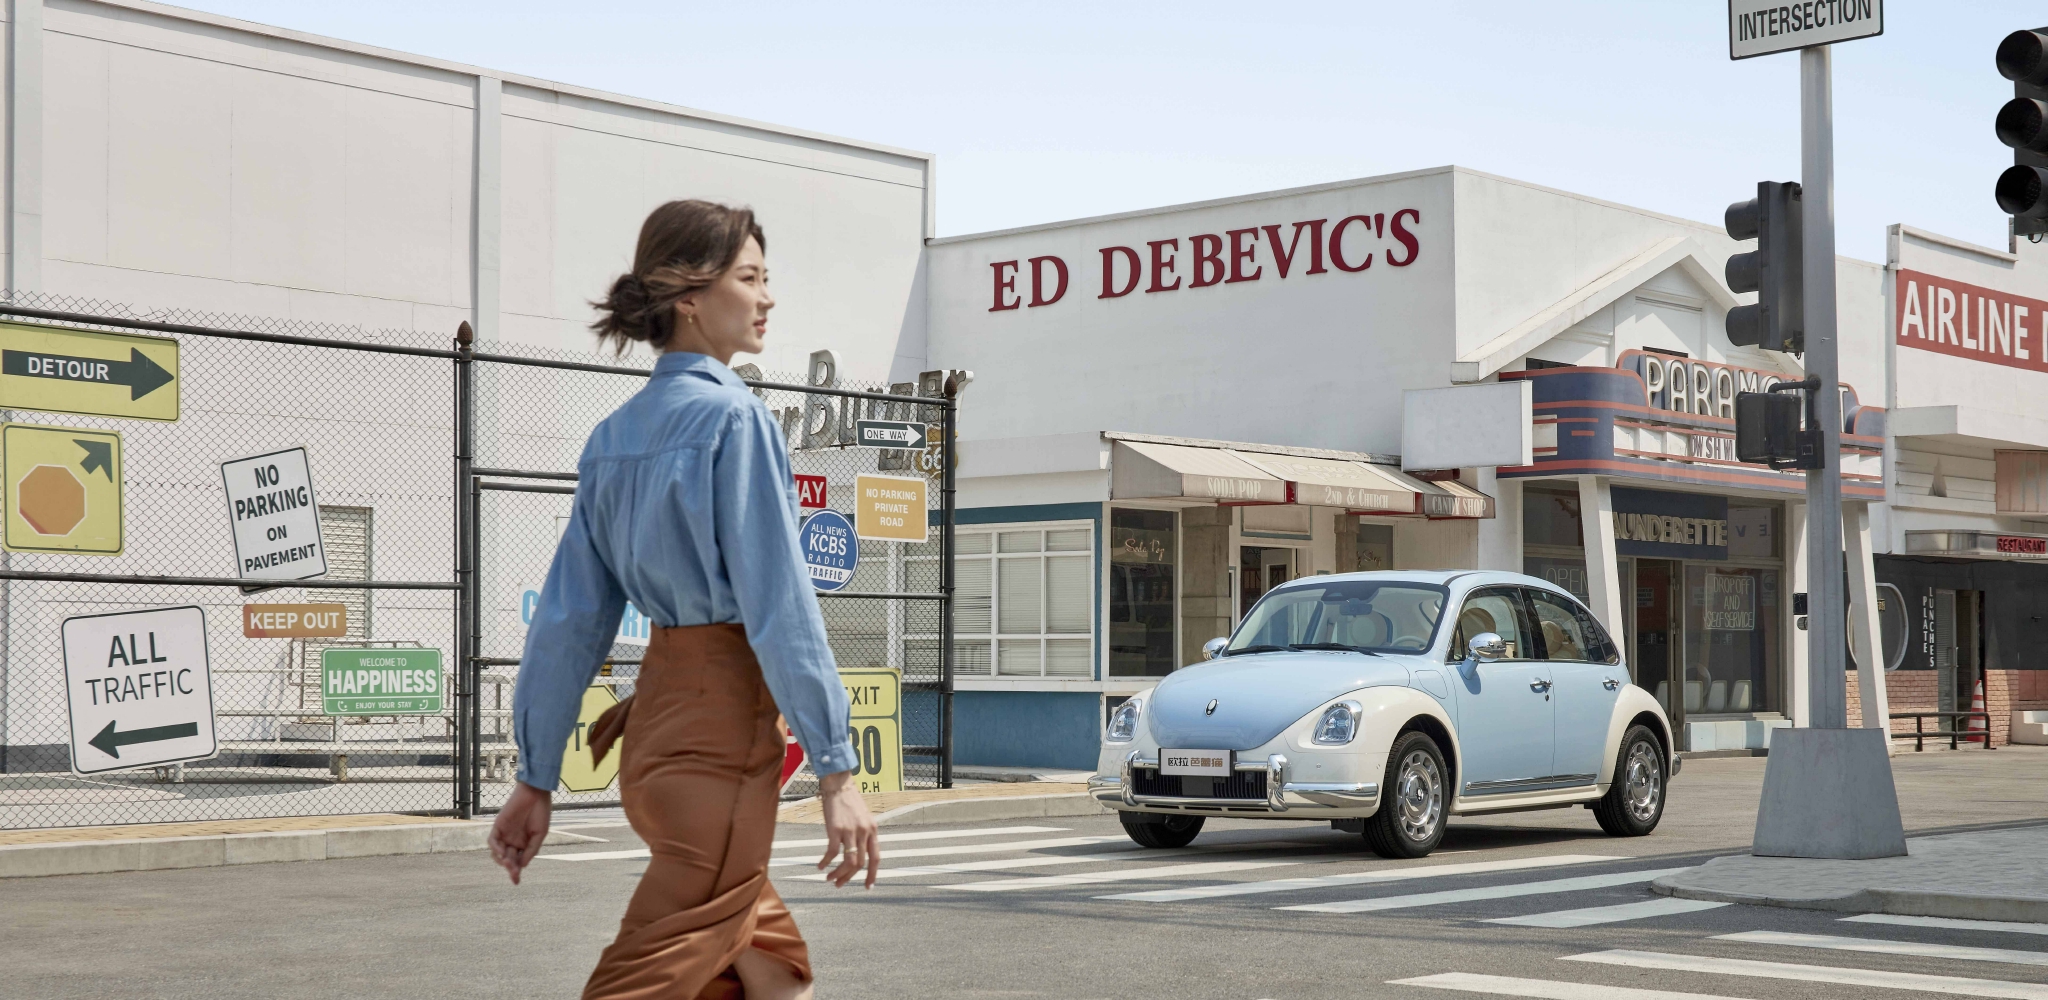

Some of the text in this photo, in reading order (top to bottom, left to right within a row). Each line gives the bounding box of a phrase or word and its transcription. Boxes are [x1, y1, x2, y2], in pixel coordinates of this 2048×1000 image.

[1739, 0, 1872, 41] INTERSECTION
[988, 208, 1420, 312] ED DEBEVIC'S
[1901, 280, 2029, 360] AIRLINE
[27, 356, 110, 381] DETOUR
[1643, 355, 1850, 433] PARAT
[866, 429, 908, 441] ONE WAY
[254, 464, 280, 489] NO
[796, 480, 825, 504] AY
[866, 488, 917, 501] NO PARKING
[1207, 477, 1262, 500] SODA POP
[1346, 487, 1356, 505] &
[235, 485, 309, 522] PARKING
[874, 502, 909, 514] PRIVATE
[1432, 495, 1487, 518] CANDY SHOP
[811, 523, 847, 537] ALL NEWS
[880, 516, 904, 527] ROAD
[266, 524, 288, 542] ON
[809, 532, 847, 556] KCBS
[1997, 537, 2046, 553] RESTAURANT
[244, 543, 316, 573] PAVEMENT
[808, 553, 845, 567] RADIO
[807, 566, 843, 581] TRAFFIC
[1545, 567, 1589, 594] OPEN
[1713, 577, 1751, 595] DROP OFF
[1723, 595, 1741, 611] AND
[250, 612, 340, 630] KEEP OUT
[1724, 611, 1753, 629] SERVICE
[108, 631, 167, 668] ALL
[359, 657, 407, 667] WELCOME TO
[85, 668, 193, 706] TRAFFIC
[328, 668, 437, 694] HAPPINESS
[355, 700, 412, 710] ENJOY YOUR STAY
[844, 686, 880, 705] XIT
